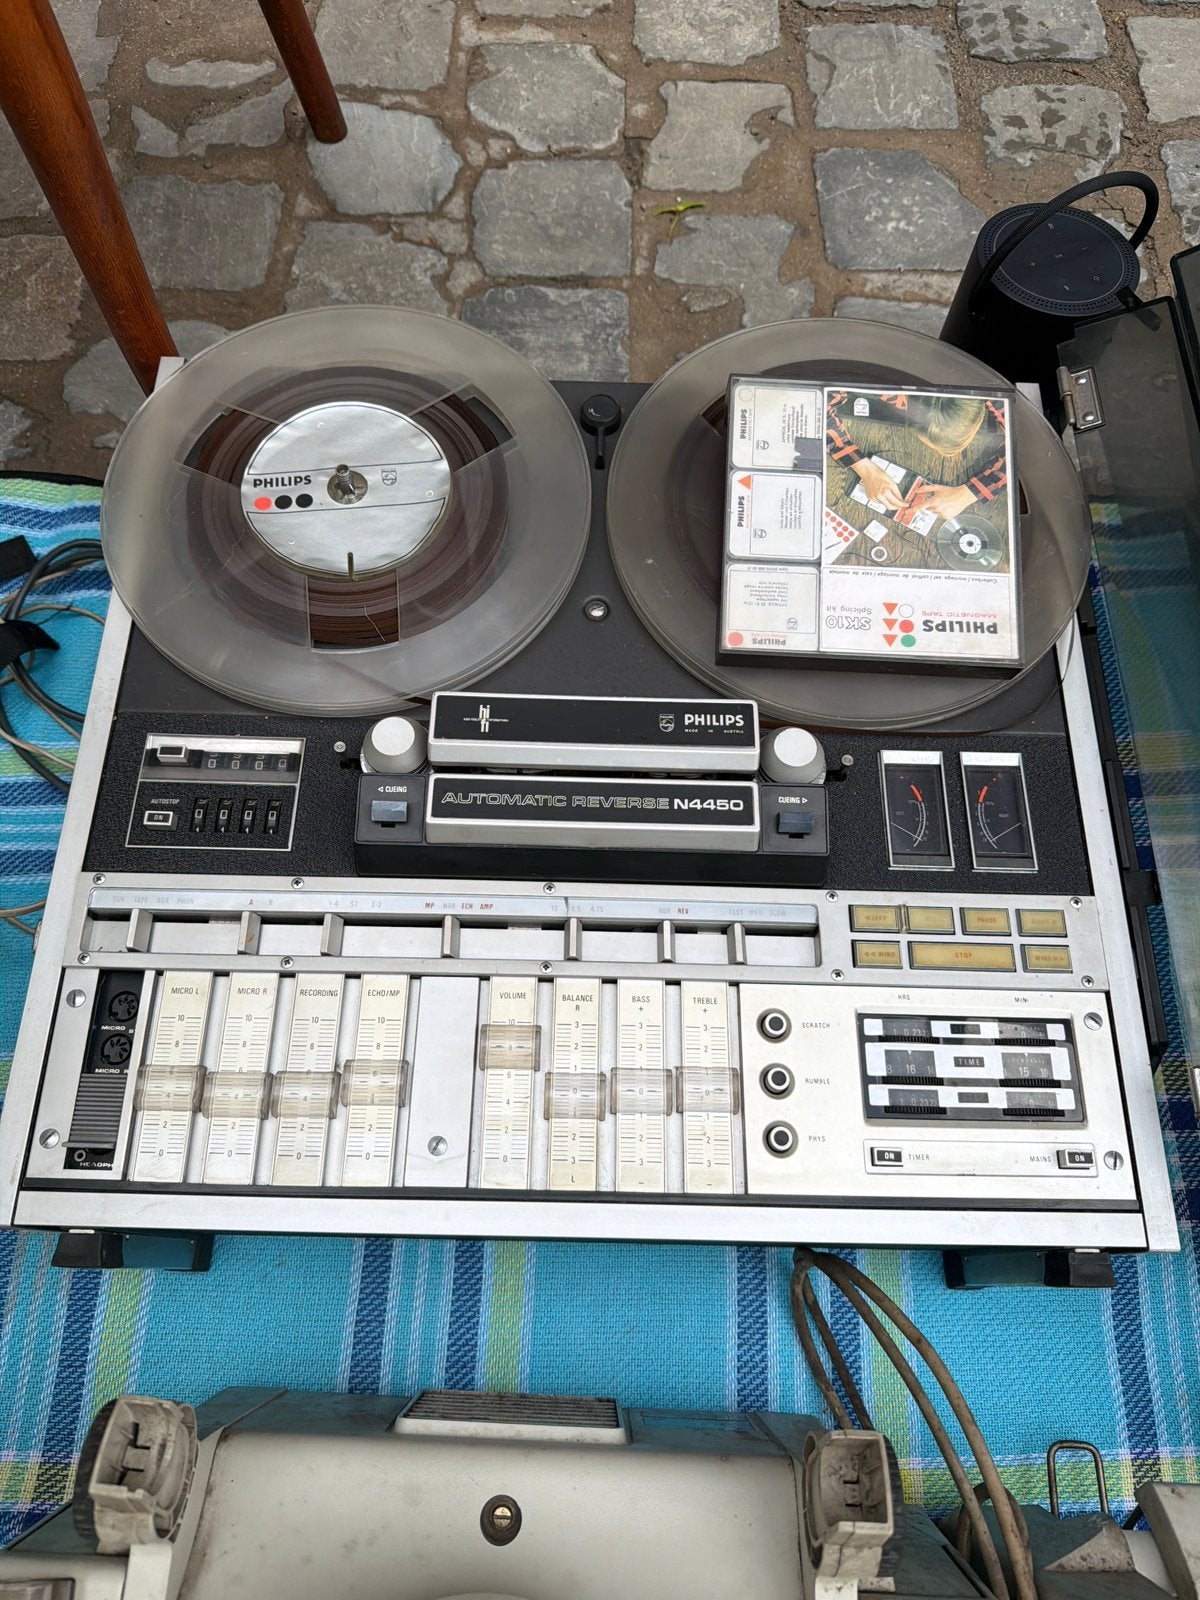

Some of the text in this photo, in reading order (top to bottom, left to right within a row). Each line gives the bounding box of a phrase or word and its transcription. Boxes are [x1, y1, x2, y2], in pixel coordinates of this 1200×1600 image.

[253, 475, 312, 488] PHILIPS
[840, 606, 872, 615] Splicing
[825, 615, 872, 631] SK10
[922, 620, 998, 634] PHILIPS
[684, 714, 744, 726] PHILIPS
[208, 759, 216, 768] 0
[232, 760, 239, 769] 0
[255, 761, 263, 770] 0
[279, 759, 286, 768] 0
[385, 785, 407, 793] CUEING
[441, 792, 744, 811] AUTOMATIC REVERSE N4450
[778, 796, 801, 804] CUEING
[195, 809, 203, 819] 0
[220, 810, 228, 819] 0
[244, 810, 252, 819] 0
[269, 811, 276, 820] 0
[171, 986, 194, 995] MICRO
[238, 987, 268, 995] MICRO R
[300, 989, 339, 997] RECORDING
[368, 989, 401, 997] ECHO/MP
[500, 991, 527, 1000] VOLUME
[562, 994, 594, 1003] BALANCE
[631, 995, 650, 1003] BASS
[693, 997, 718, 1005] TREBLE
[177, 1014, 185, 1022] 10
[311, 1016, 319, 1024] 10
[377, 1016, 385, 1024] 10
[175, 1040, 180, 1048] 8
[242, 1040, 247, 1048] 8
[309, 1042, 315, 1050] 8
[376, 1042, 381, 1050] 8
[958, 1058, 980, 1066] TIME
[906, 1064, 916, 1073] 16
[1018, 1067, 1029, 1077] 15
[368, 1124, 372, 1132] 2
[158, 1149, 163, 1157] 0
[227, 1150, 232, 1158] 0
[296, 1152, 301, 1160] 0
[365, 1152, 370, 1160] 0
[884, 1152, 895, 1160] ON
[908, 1153, 930, 1161] TIMER
[1029, 1155, 1052, 1163] MAINS
[1074, 1154, 1085, 1162] ON
[706, 1160, 712, 1168] 3
